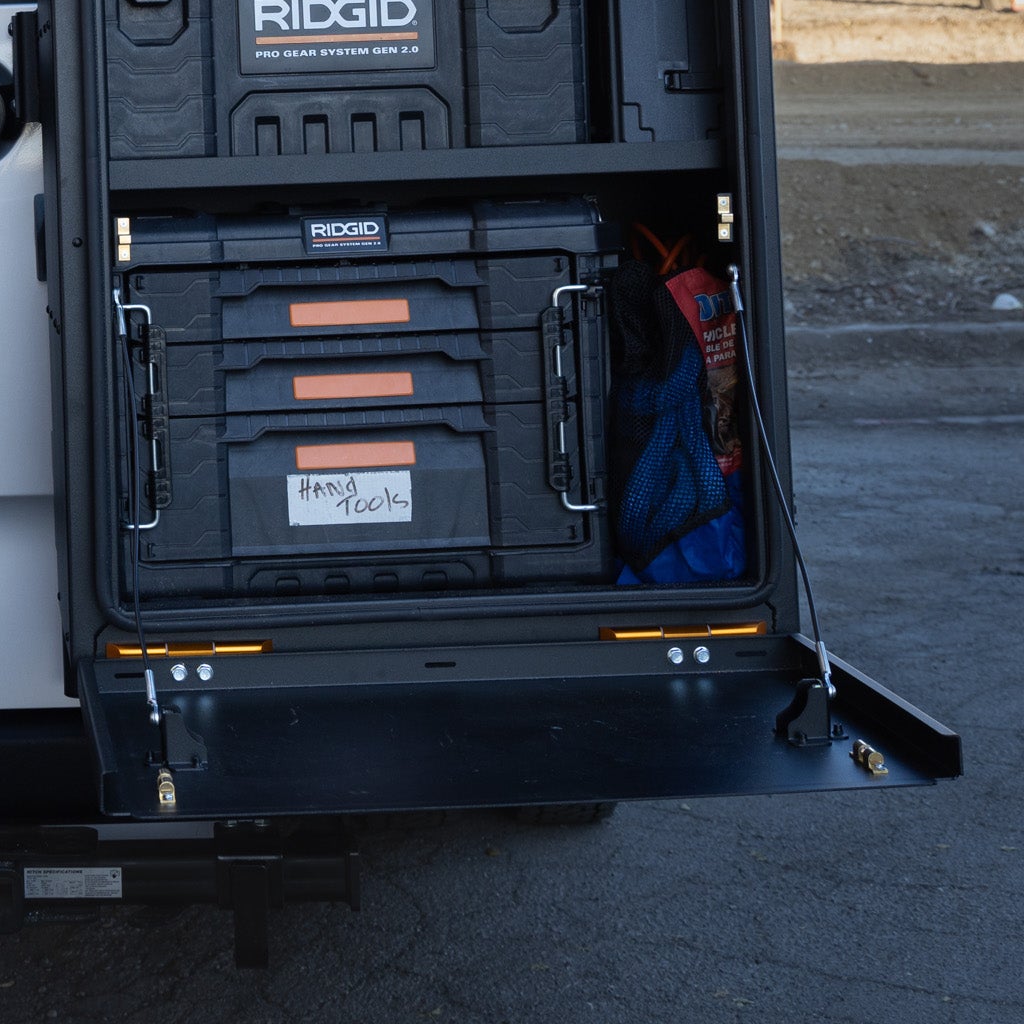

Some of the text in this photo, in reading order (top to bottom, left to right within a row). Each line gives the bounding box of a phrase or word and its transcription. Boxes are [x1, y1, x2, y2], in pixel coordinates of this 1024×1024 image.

[255, 46, 419, 59] PRO GEAR SYSTEM GEN 2.0
[311, 222, 379, 237] RIDGID
